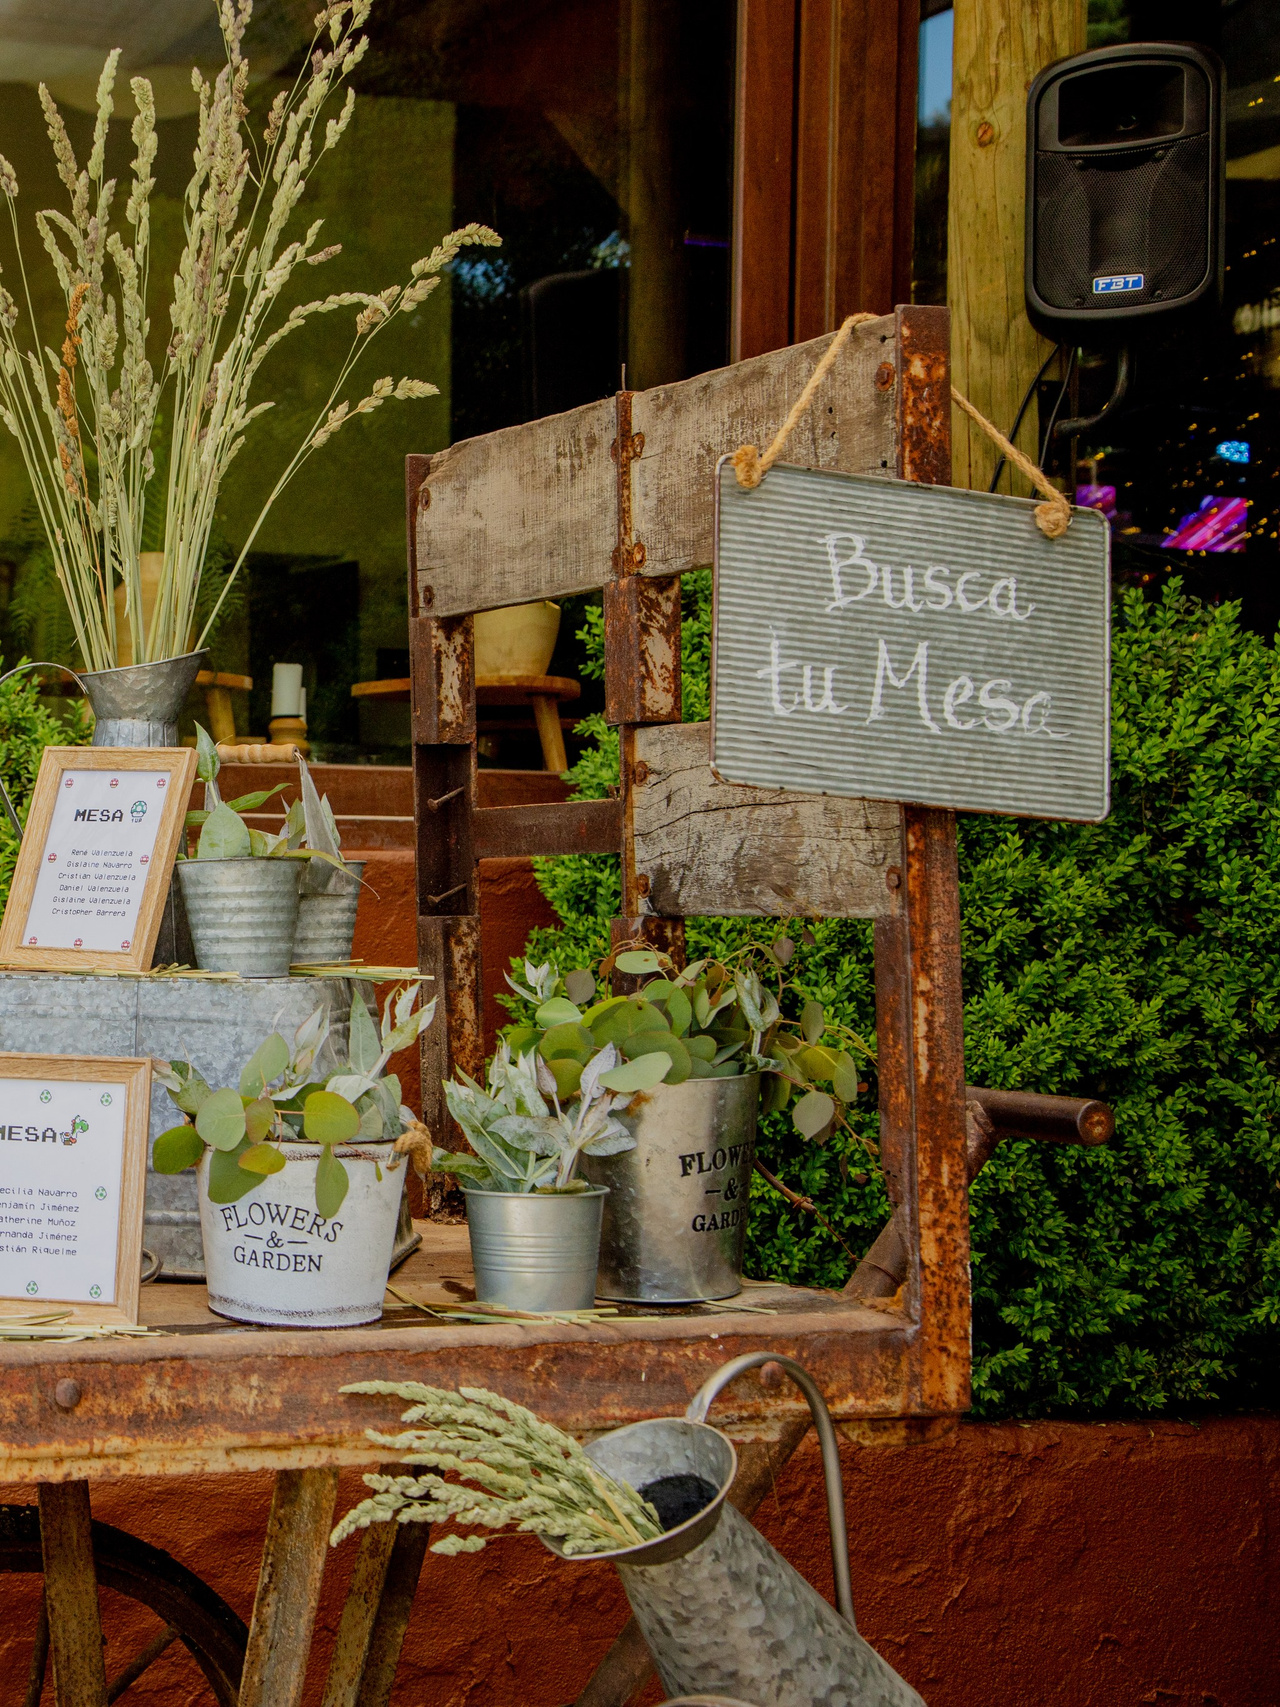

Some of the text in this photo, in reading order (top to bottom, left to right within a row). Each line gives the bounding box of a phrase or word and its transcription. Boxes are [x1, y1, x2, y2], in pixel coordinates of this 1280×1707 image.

[1098, 276, 1139, 291] FBT
[816, 532, 1036, 620] Busca
[756, 625, 1070, 738] tu Mesa
[74, 809, 124, 822] MESA
[58, 872, 90, 880] Cristian
[88, 885, 129, 893] Valenzuela
[89, 897, 131, 905] Valenzuela
[52, 908, 93, 916] Cristopher
[38, 1188, 78, 1198] Navarro
[40, 1203, 80, 1213] Jiménez
[47, 1218, 76, 1227] Muñoz
[220, 1202, 344, 1243] FLOWERS
[38, 1231, 78, 1242] Jiménez
[32, 1246, 77, 1256] Riquelme
[233, 1245, 323, 1272] GARDEN
